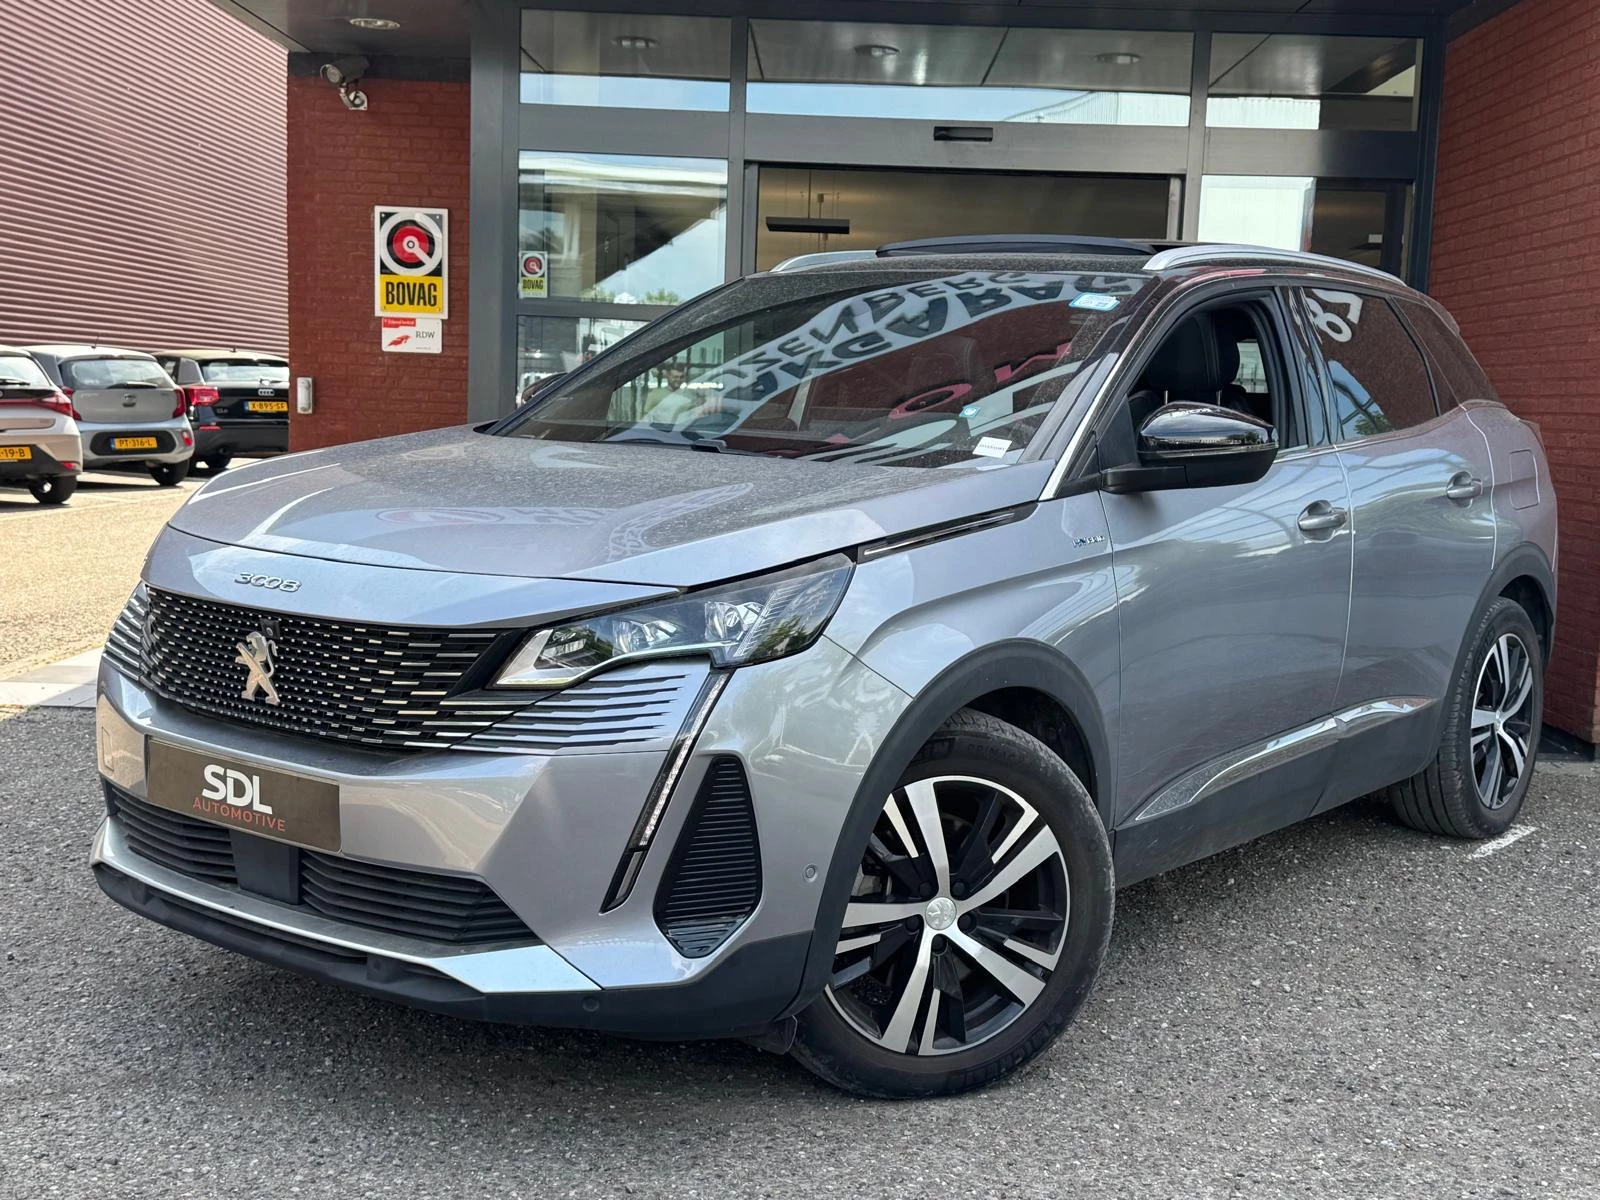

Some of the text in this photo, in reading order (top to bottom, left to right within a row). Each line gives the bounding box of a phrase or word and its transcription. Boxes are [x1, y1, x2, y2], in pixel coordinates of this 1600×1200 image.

[385, 281, 438, 307] BOVAG
[415, 330, 436, 339] RDW
[0, 447, 26, 458] -19-B
[234, 572, 302, 593] 3008
[201, 764, 273, 815] SDL
[192, 797, 287, 832] AUTOMOTIVE
